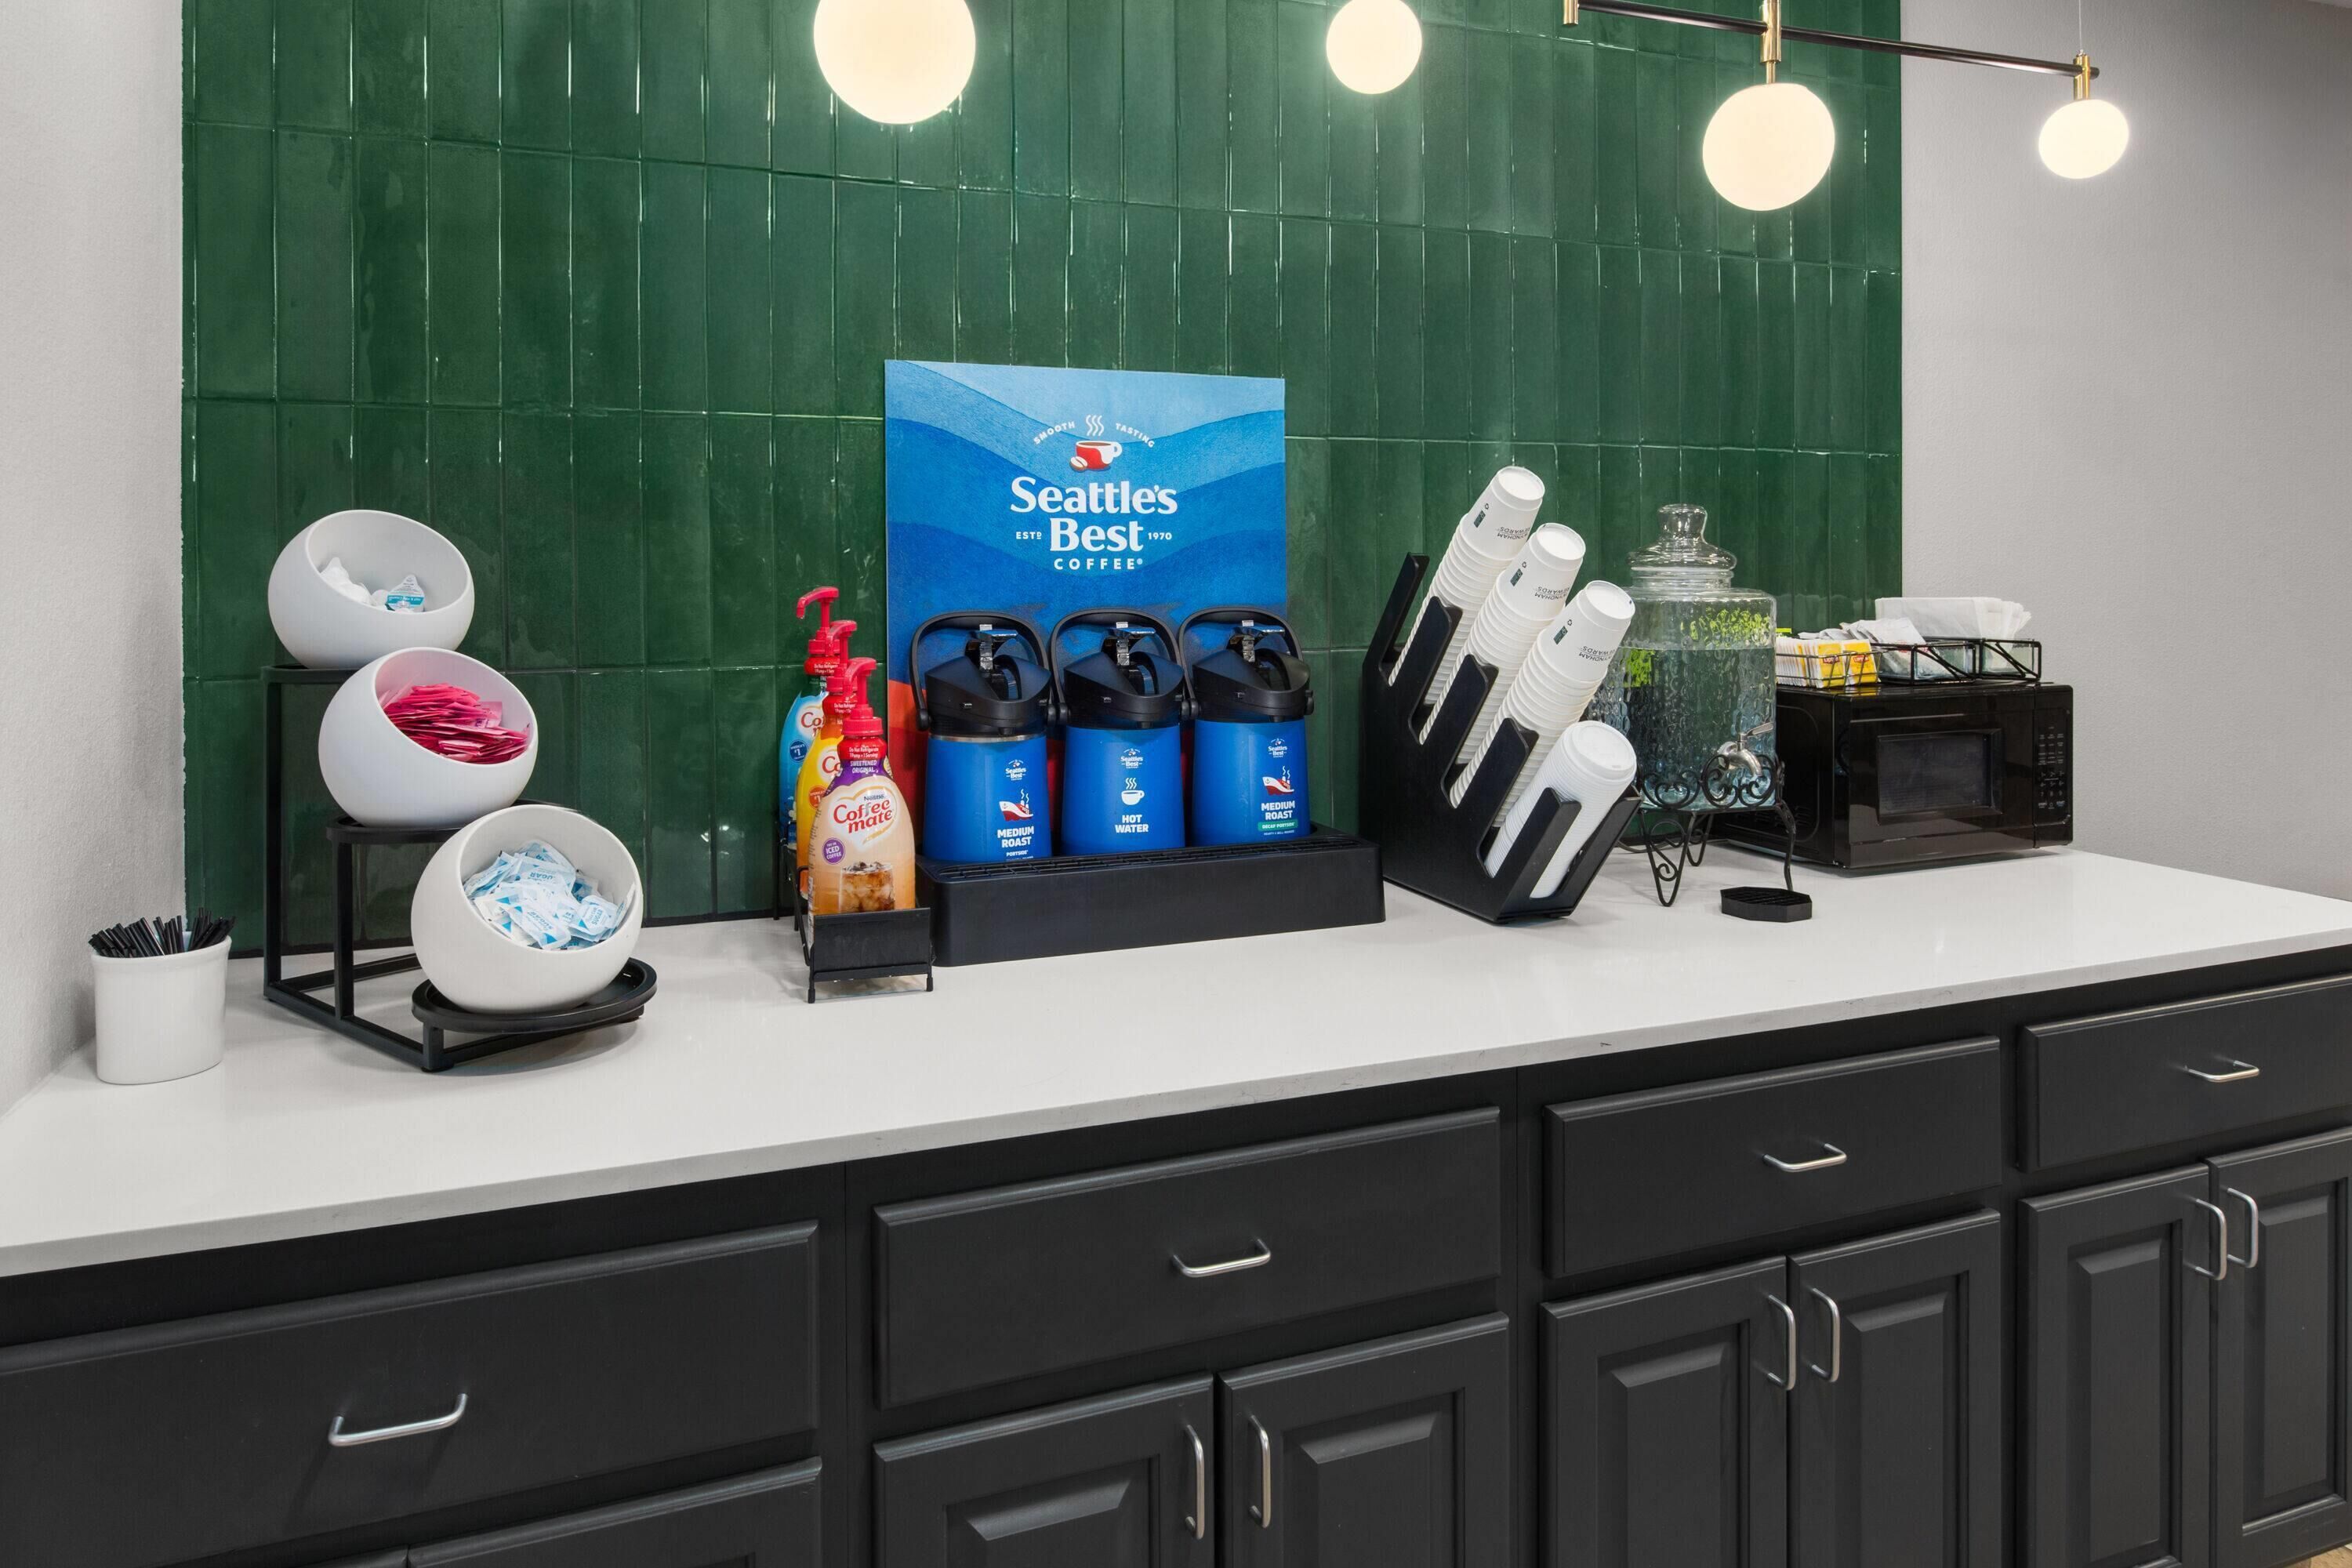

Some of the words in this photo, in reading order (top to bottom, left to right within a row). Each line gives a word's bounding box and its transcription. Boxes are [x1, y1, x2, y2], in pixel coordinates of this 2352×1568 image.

[1033, 421, 1076, 445] SMOOTH
[1115, 423, 1155, 448] TASTING
[1010, 476, 1178, 514] Seattle's
[1050, 517, 1144, 552] Best
[833, 799, 890, 824] Coffee
[1261, 800, 1295, 811] MEDIUM
[1122, 815, 1142, 823] HOT
[1265, 810, 1293, 820] ROAST
[848, 810, 892, 833] mate
[997, 826, 1034, 838] MEDIUM
[1115, 823, 1149, 833] WATER
[1001, 837, 1032, 848] ROAST
